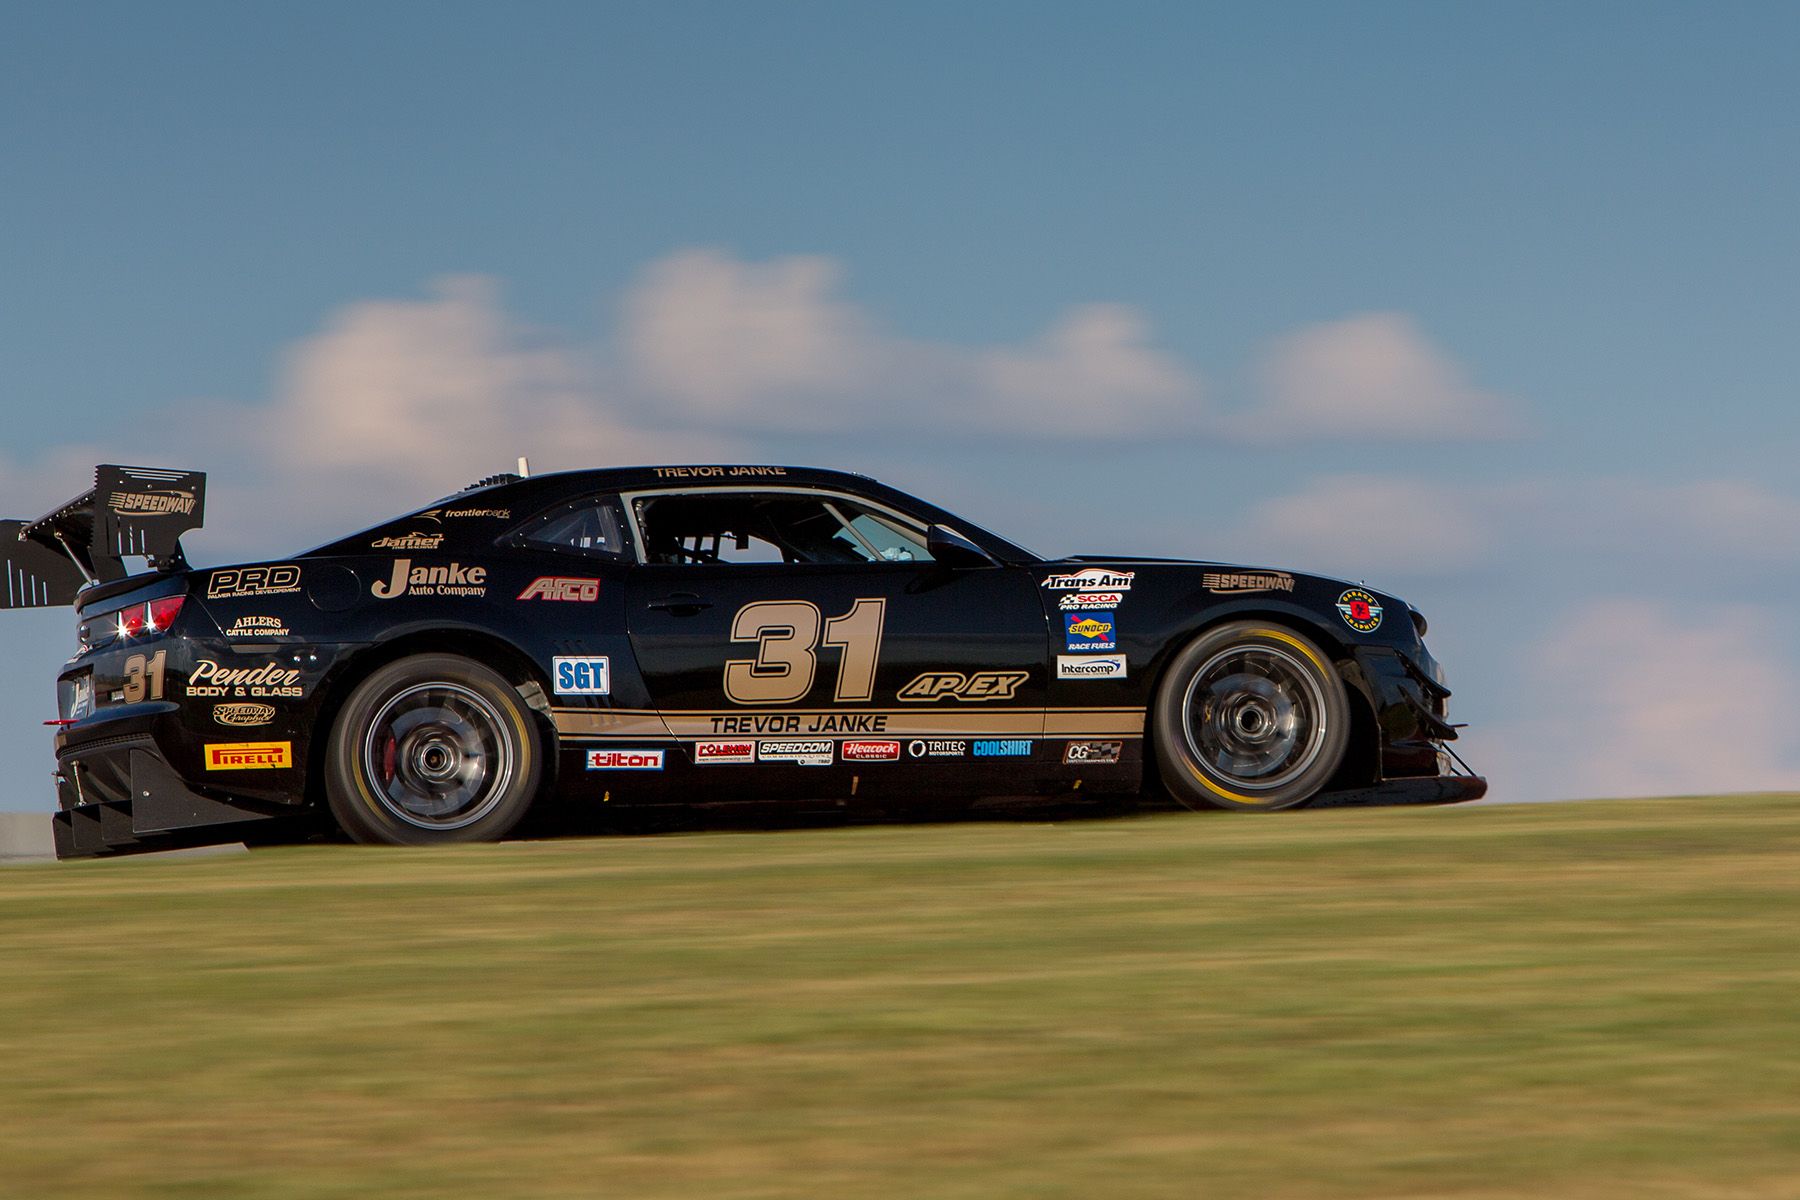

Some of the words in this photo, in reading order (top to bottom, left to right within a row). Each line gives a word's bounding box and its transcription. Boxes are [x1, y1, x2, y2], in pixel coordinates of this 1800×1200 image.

[653, 467, 724, 477] TREVOR
[728, 466, 787, 476] JANKE
[124, 493, 196, 515] SPEEDWAY
[207, 565, 301, 595] PRD
[371, 559, 487, 599] Janke
[1049, 576, 1096, 588] Trans
[1098, 575, 1129, 586] Am
[1220, 574, 1295, 592] SPEEDWAY
[408, 585, 434, 596] Auto
[436, 585, 487, 598] Company
[1077, 594, 1119, 602] SCCA
[234, 616, 282, 629] AHLERS
[1071, 624, 1109, 633] SUNOCO
[1344, 613, 1379, 630] GRAPHICS
[254, 628, 290, 636] COMPANY
[723, 597, 887, 705] 31
[1090, 642, 1116, 650] FUELS
[188, 659, 300, 686] Pender
[558, 662, 604, 689] SGT
[1061, 663, 1114, 674] Intercomp
[123, 650, 167, 705] 31
[186, 686, 229, 696] BODY
[234, 687, 246, 696] &
[251, 686, 303, 697] GLASS
[710, 717, 800, 733] TREVOR
[808, 716, 888, 732] JANKE
[761, 743, 831, 753] SPEEDCOM
[846, 743, 895, 754] Heacock
[928, 741, 966, 751] TRITEC
[973, 740, 1032, 756] COOLSHIRT
[212, 748, 283, 765] PIRELLI
[592, 752, 659, 767] tilton
